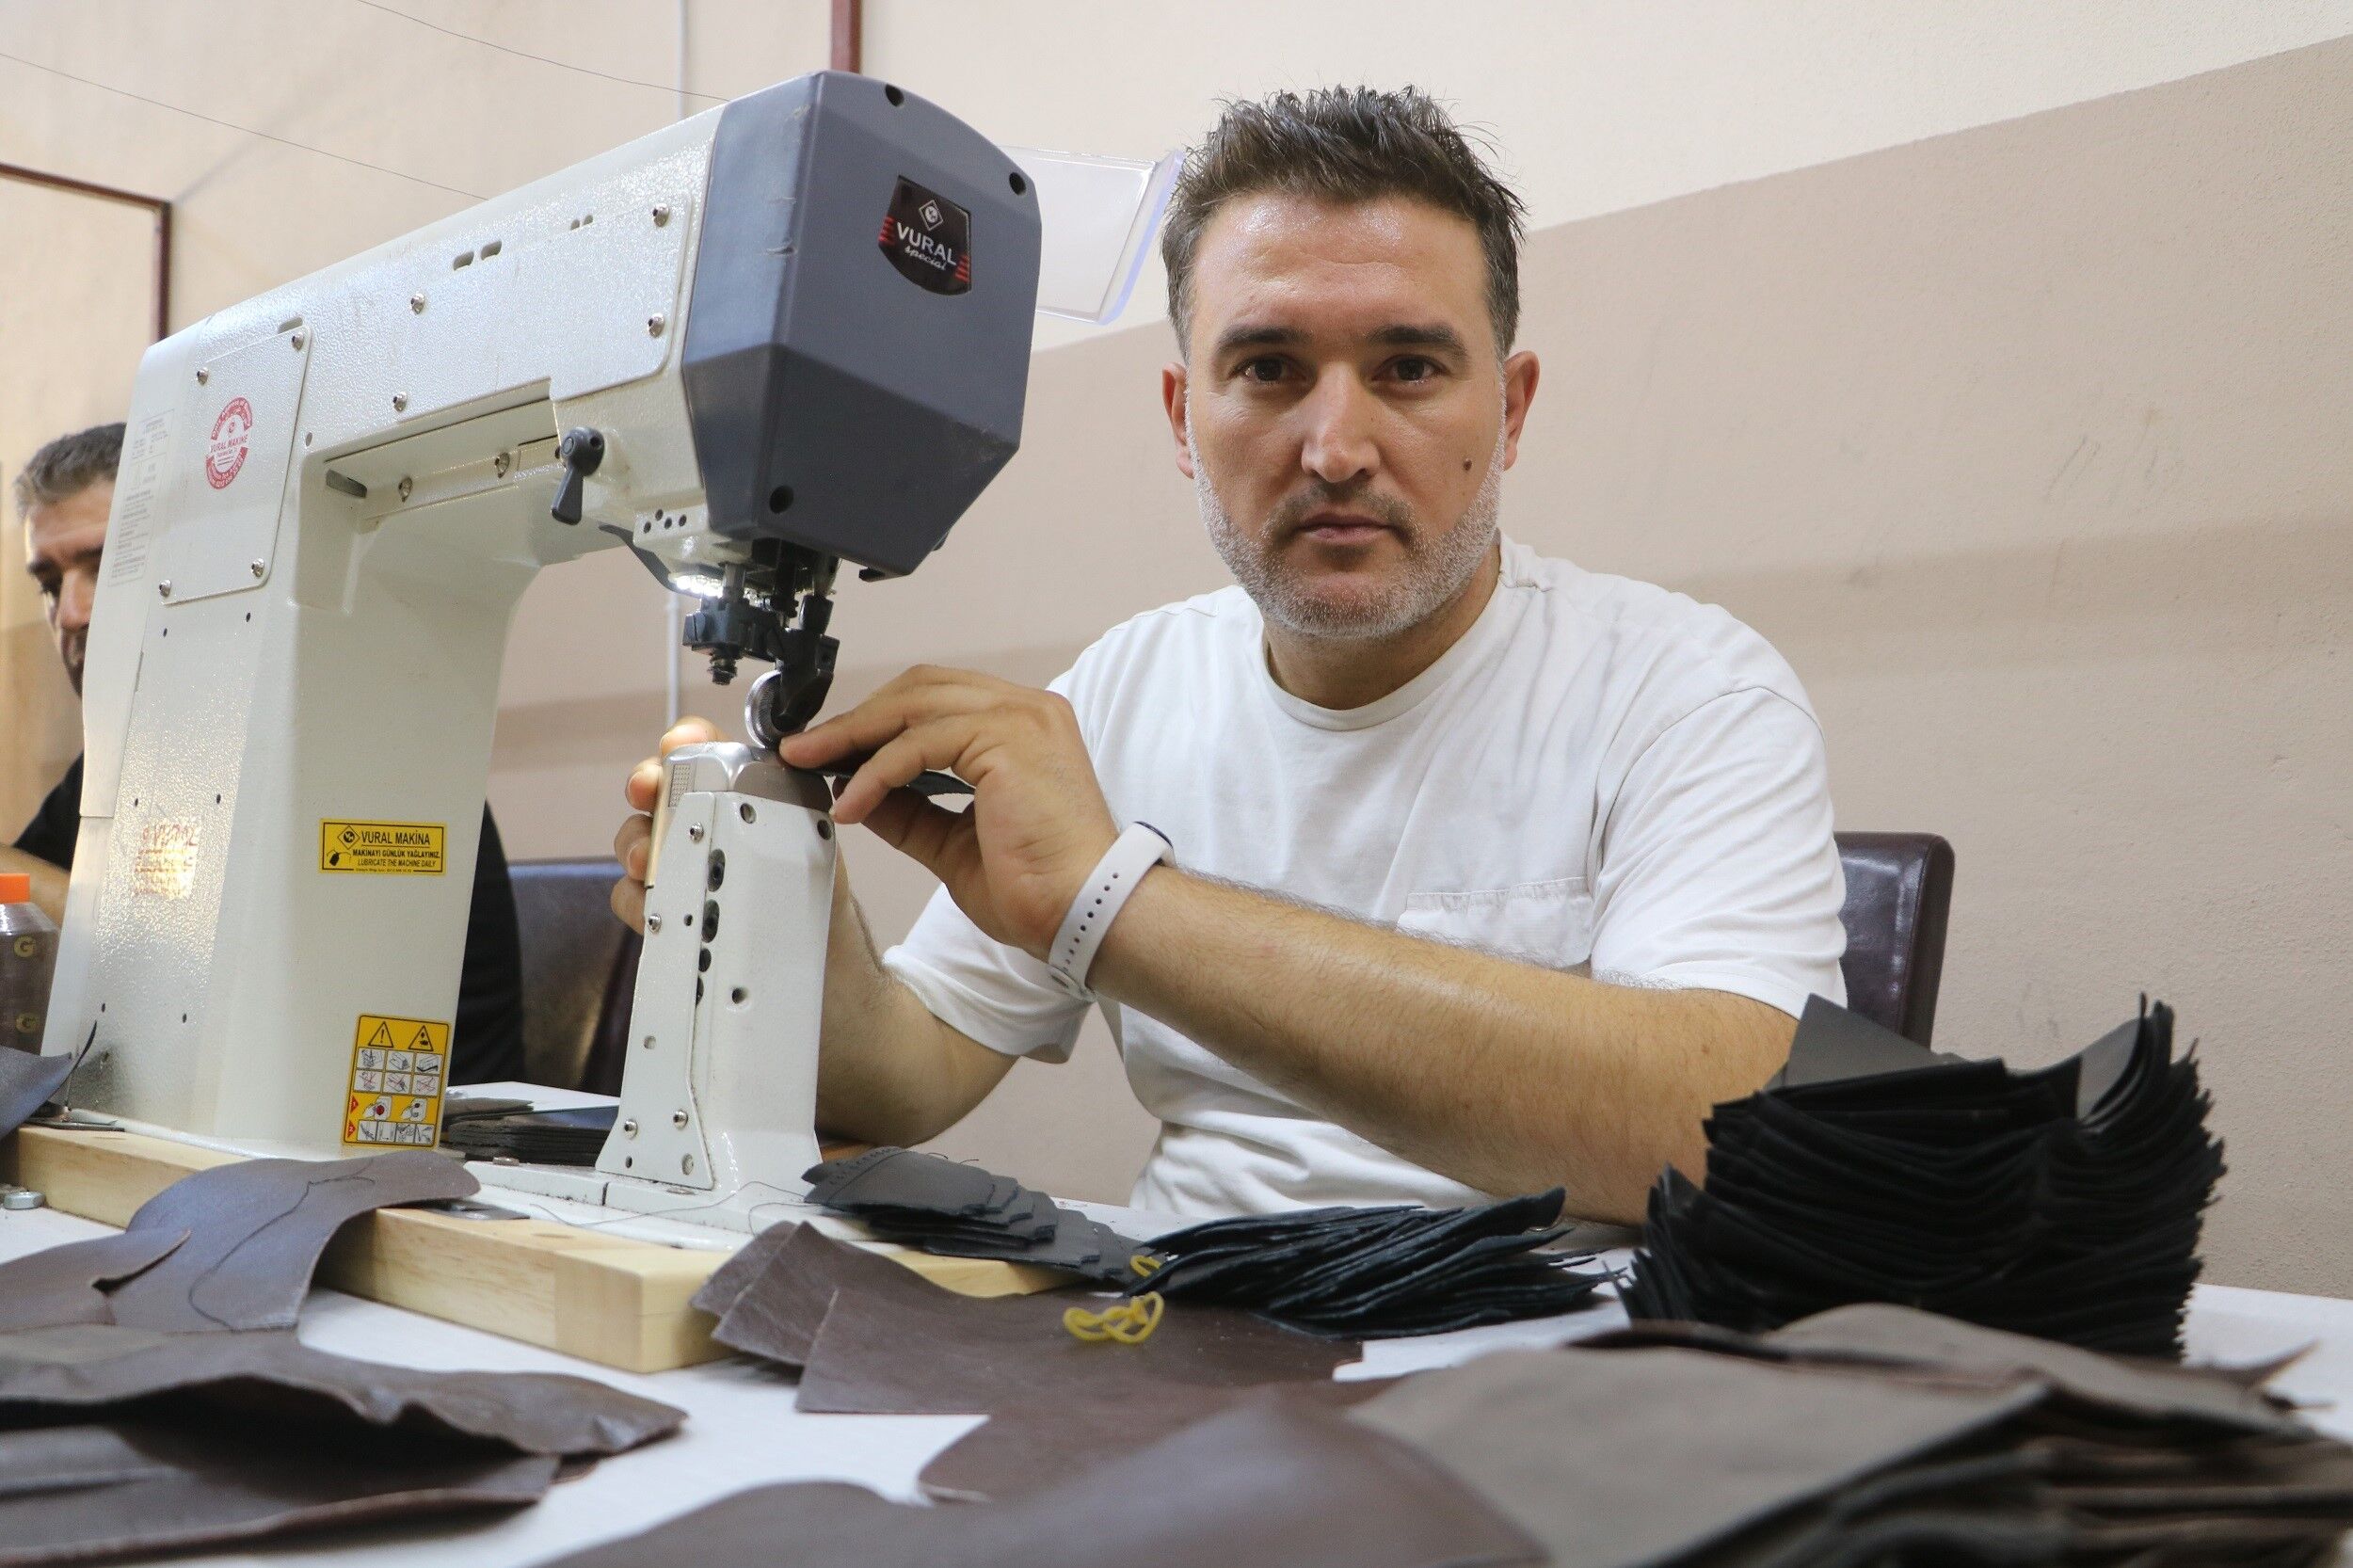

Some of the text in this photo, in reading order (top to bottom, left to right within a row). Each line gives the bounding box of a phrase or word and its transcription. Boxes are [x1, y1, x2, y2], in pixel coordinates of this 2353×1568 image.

[896, 221, 957, 266] VURAL
[361, 830, 431, 845] VURAL MAKİNA
[358, 858, 387, 867] LUBRICATE
[398, 859, 421, 868] MACHINE
